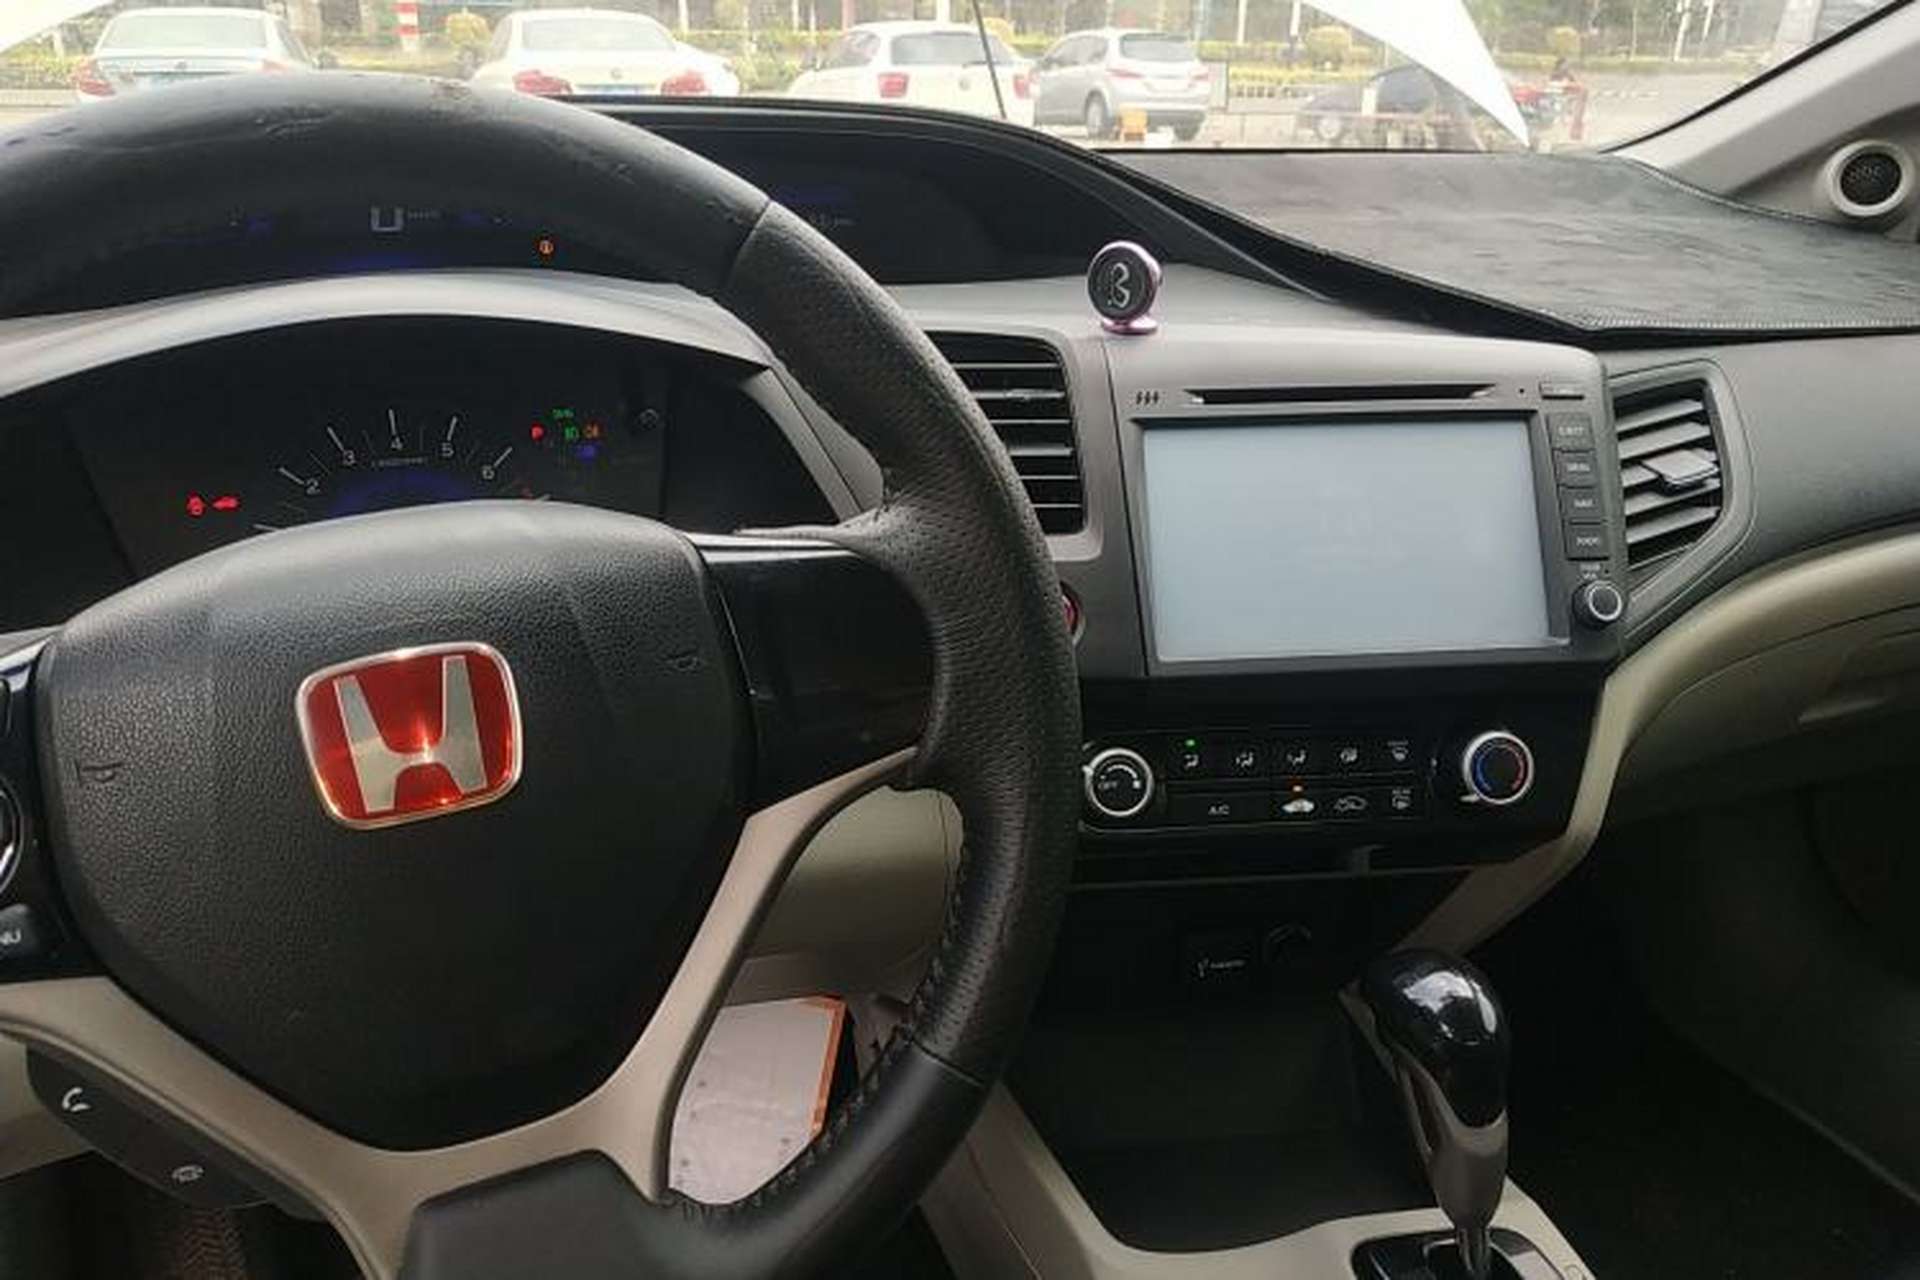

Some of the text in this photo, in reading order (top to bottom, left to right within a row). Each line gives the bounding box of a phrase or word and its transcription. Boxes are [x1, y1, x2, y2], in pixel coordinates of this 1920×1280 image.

[391, 435, 403, 450] 4
[442, 442, 454, 457] 5
[343, 450, 356, 466] 3
[482, 465, 495, 480] 6
[305, 479, 320, 495] 2
